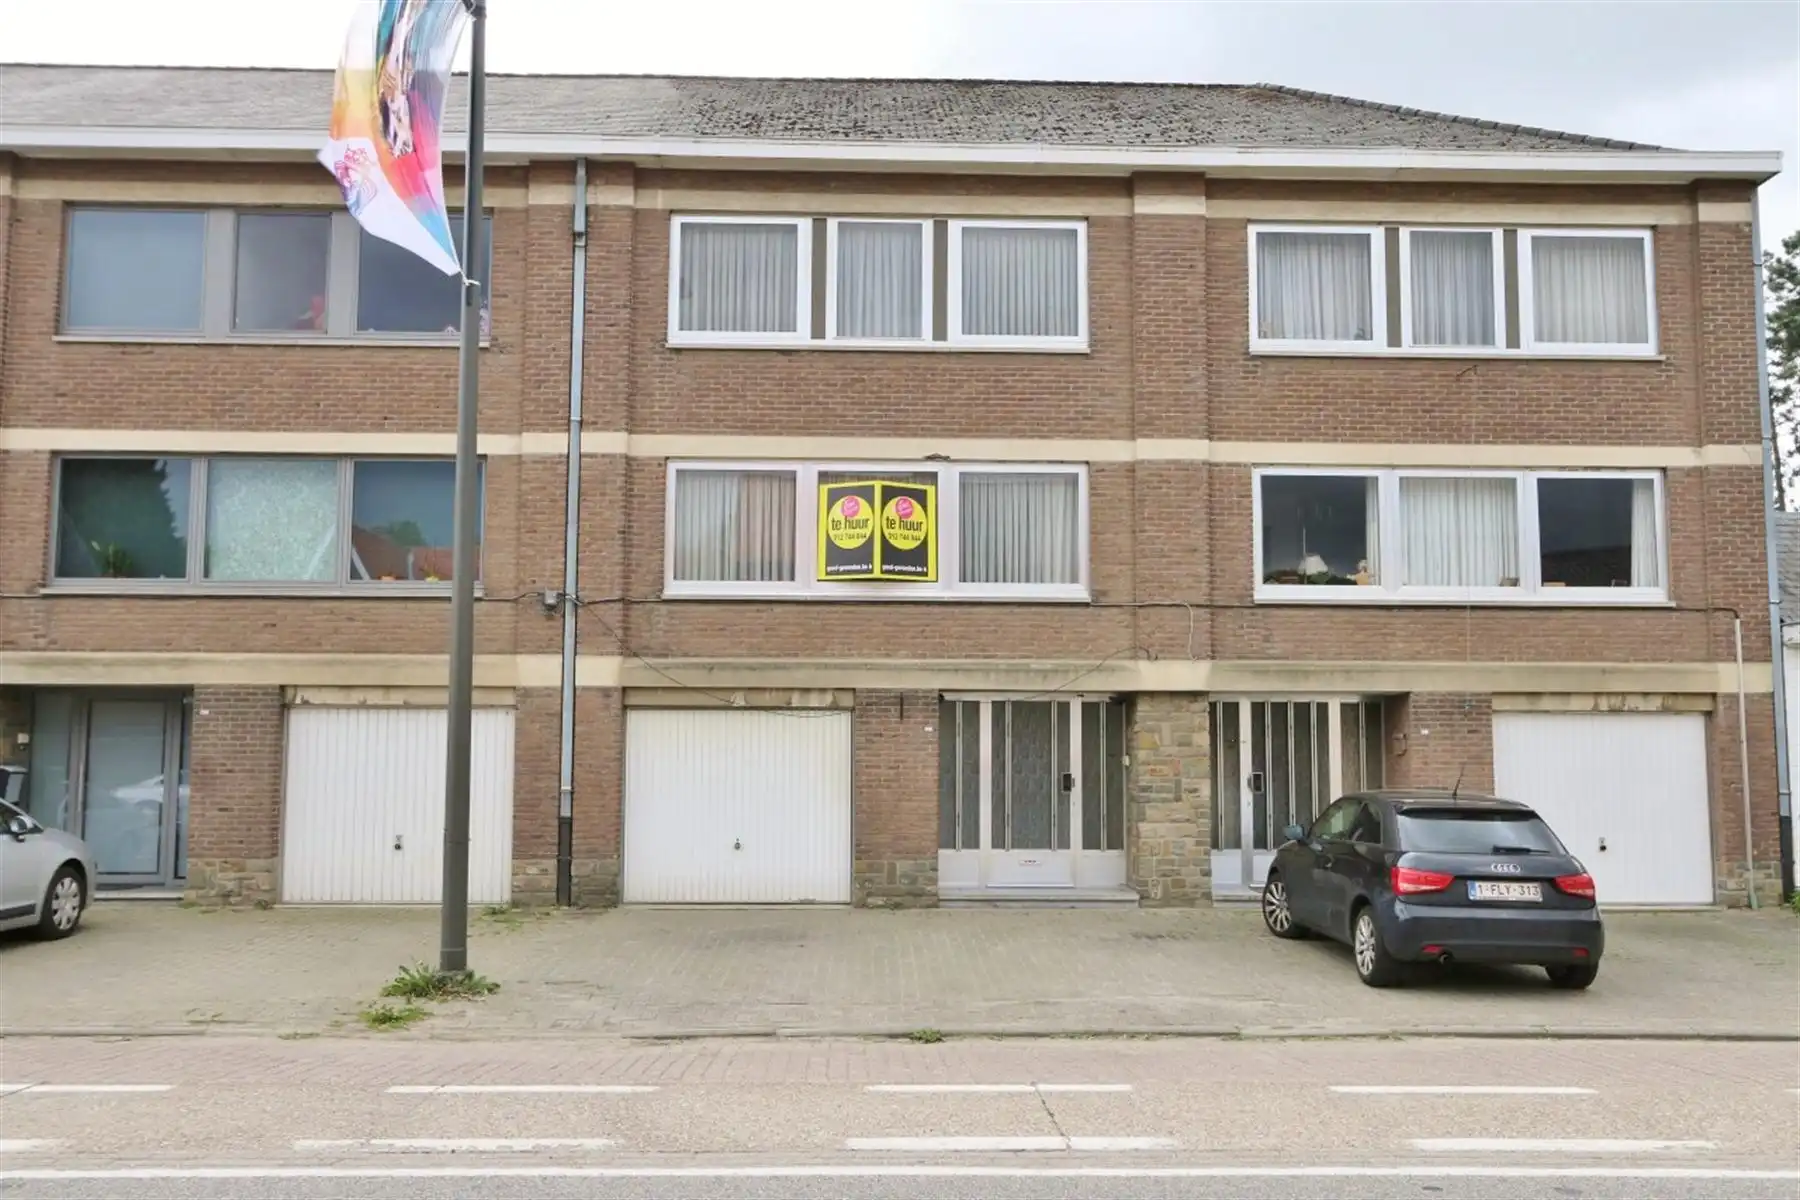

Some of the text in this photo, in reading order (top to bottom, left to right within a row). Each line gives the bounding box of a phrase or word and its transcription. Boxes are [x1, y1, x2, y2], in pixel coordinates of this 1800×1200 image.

[831, 515, 870, 531] te huur
[885, 515, 924, 532] te huur
[1477, 884, 1540, 897] 1-FLY-313
